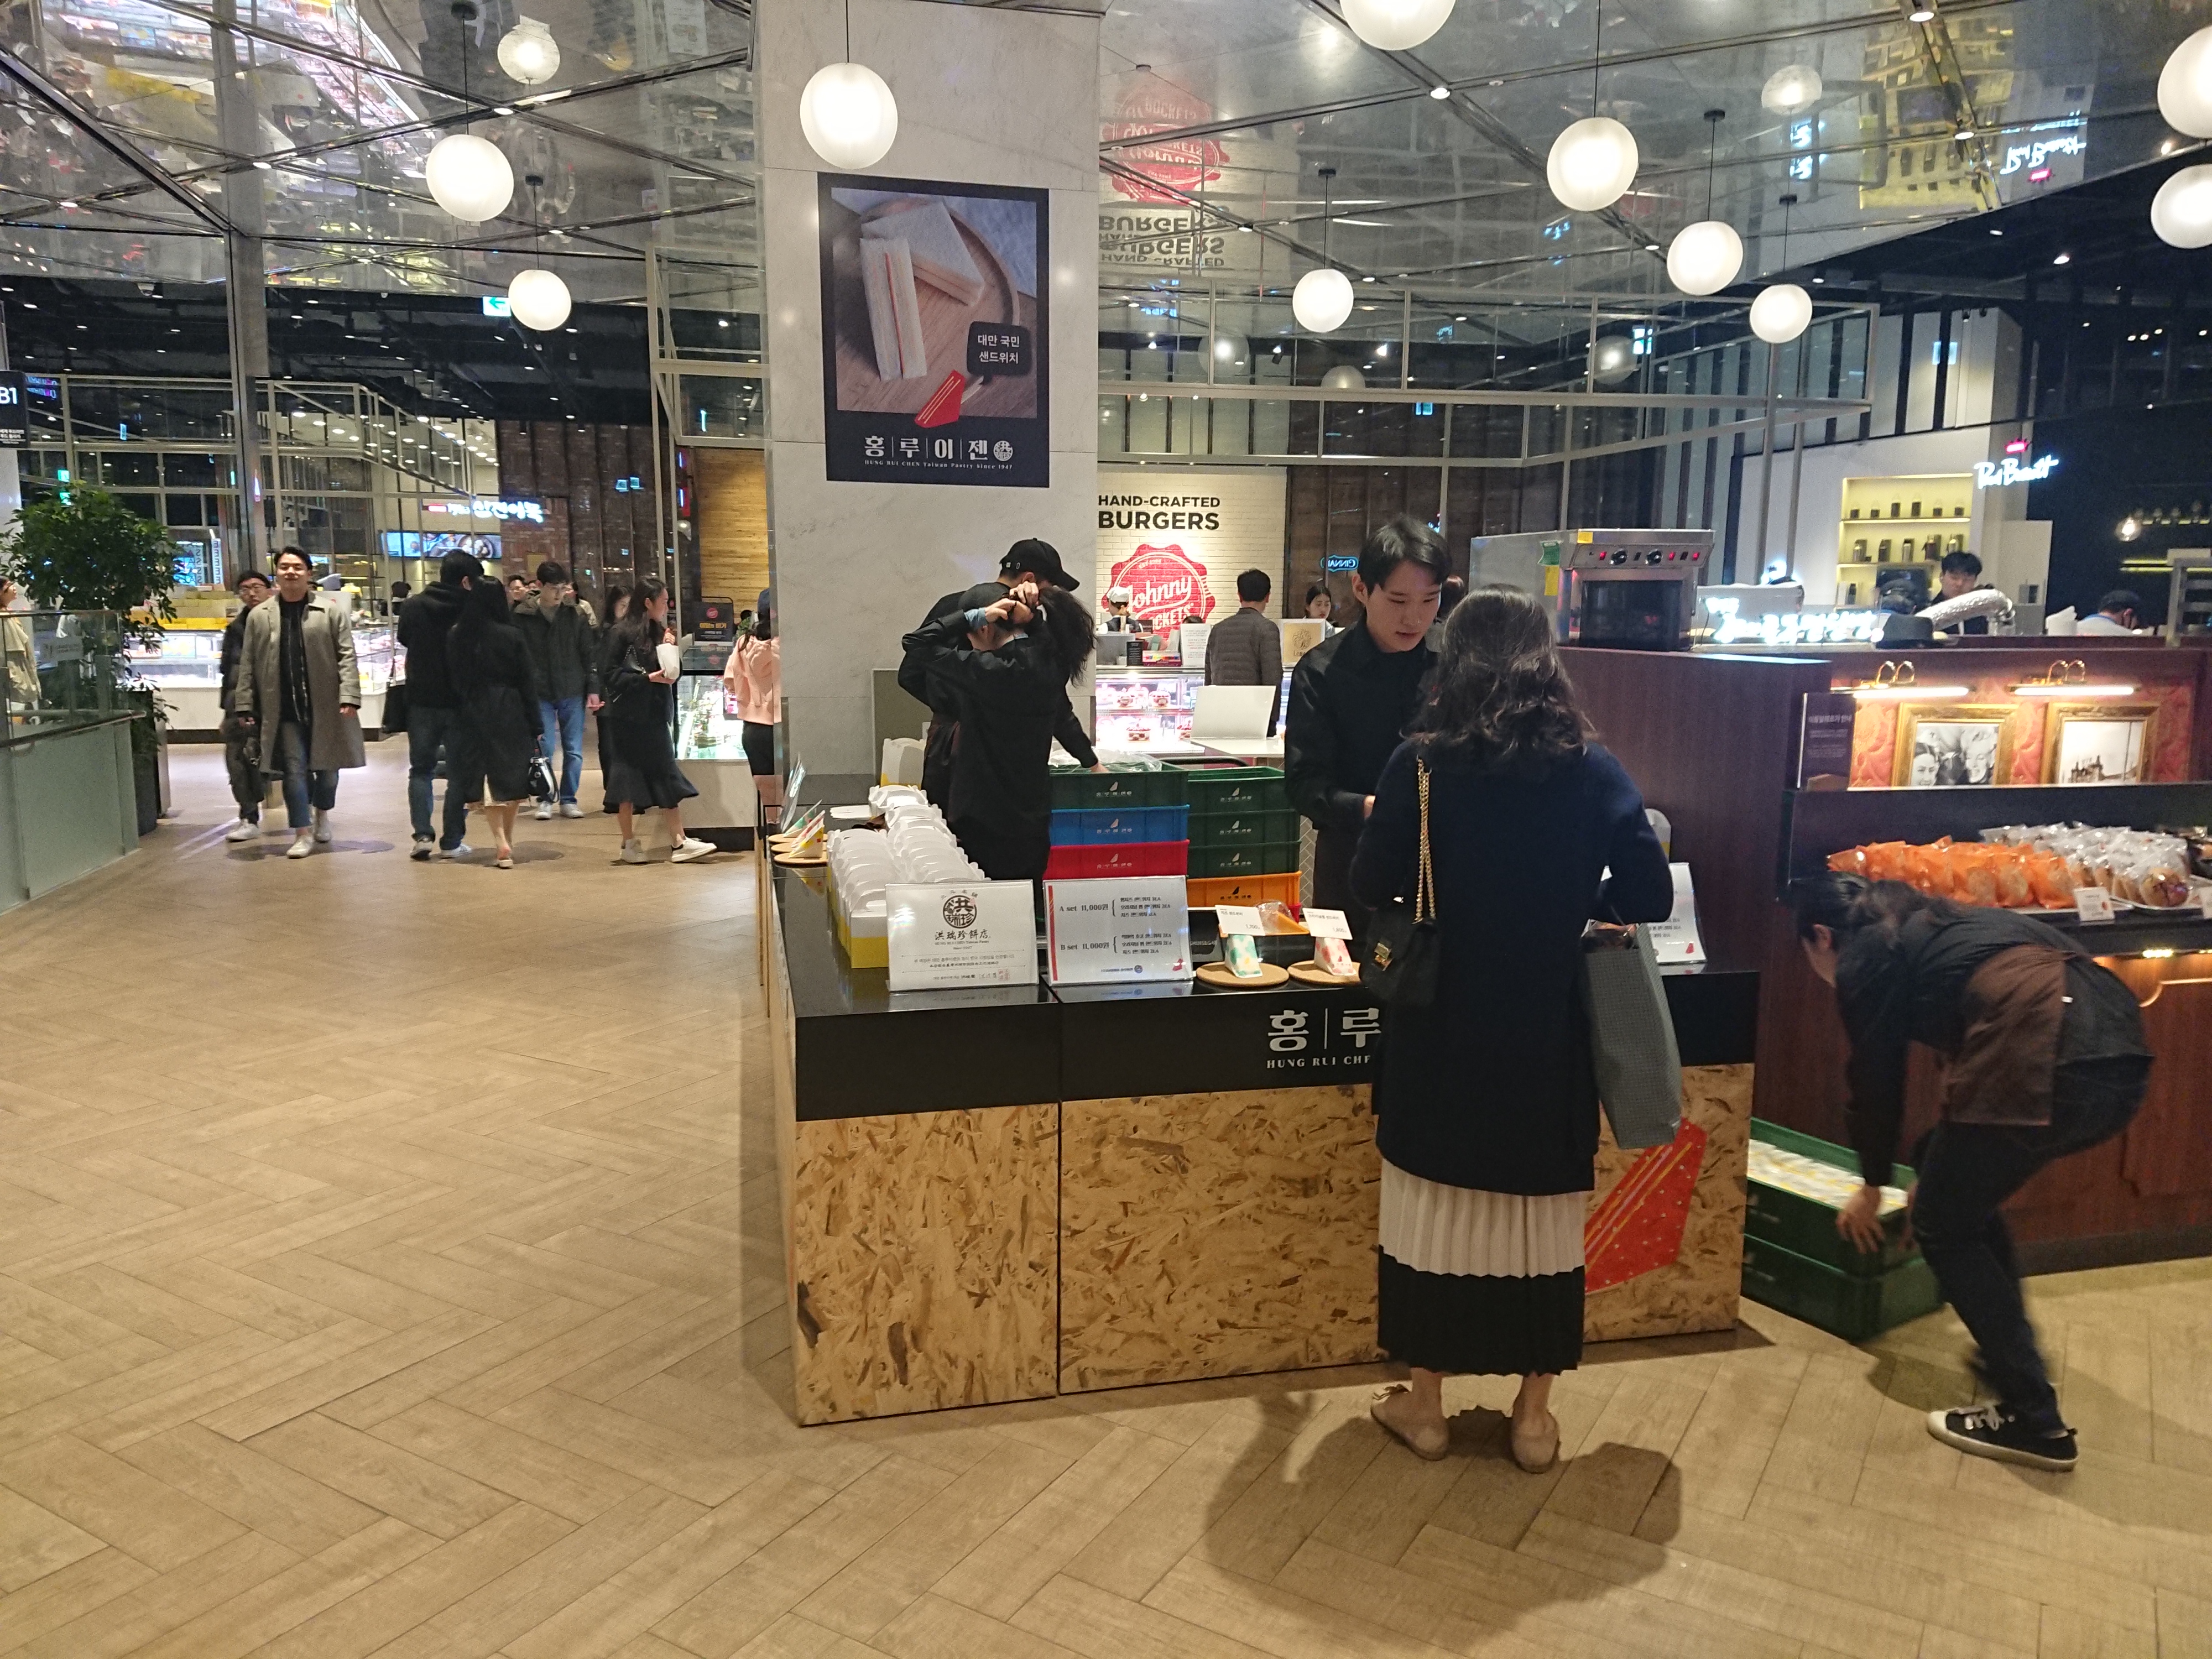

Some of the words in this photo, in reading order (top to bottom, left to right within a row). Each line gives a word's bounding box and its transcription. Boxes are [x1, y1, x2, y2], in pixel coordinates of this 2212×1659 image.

[978, 334, 998, 346] 대만
[1000, 336, 1020, 348] 국민
[979, 351, 1018, 364] 샌드위치
[1098, 495, 1220, 508] HAND-CRAFTED
[1098, 510, 1219, 530] BURGERS
[1152, 606, 1192, 630] CKETS
[1267, 1058, 1305, 1069] HUNG
